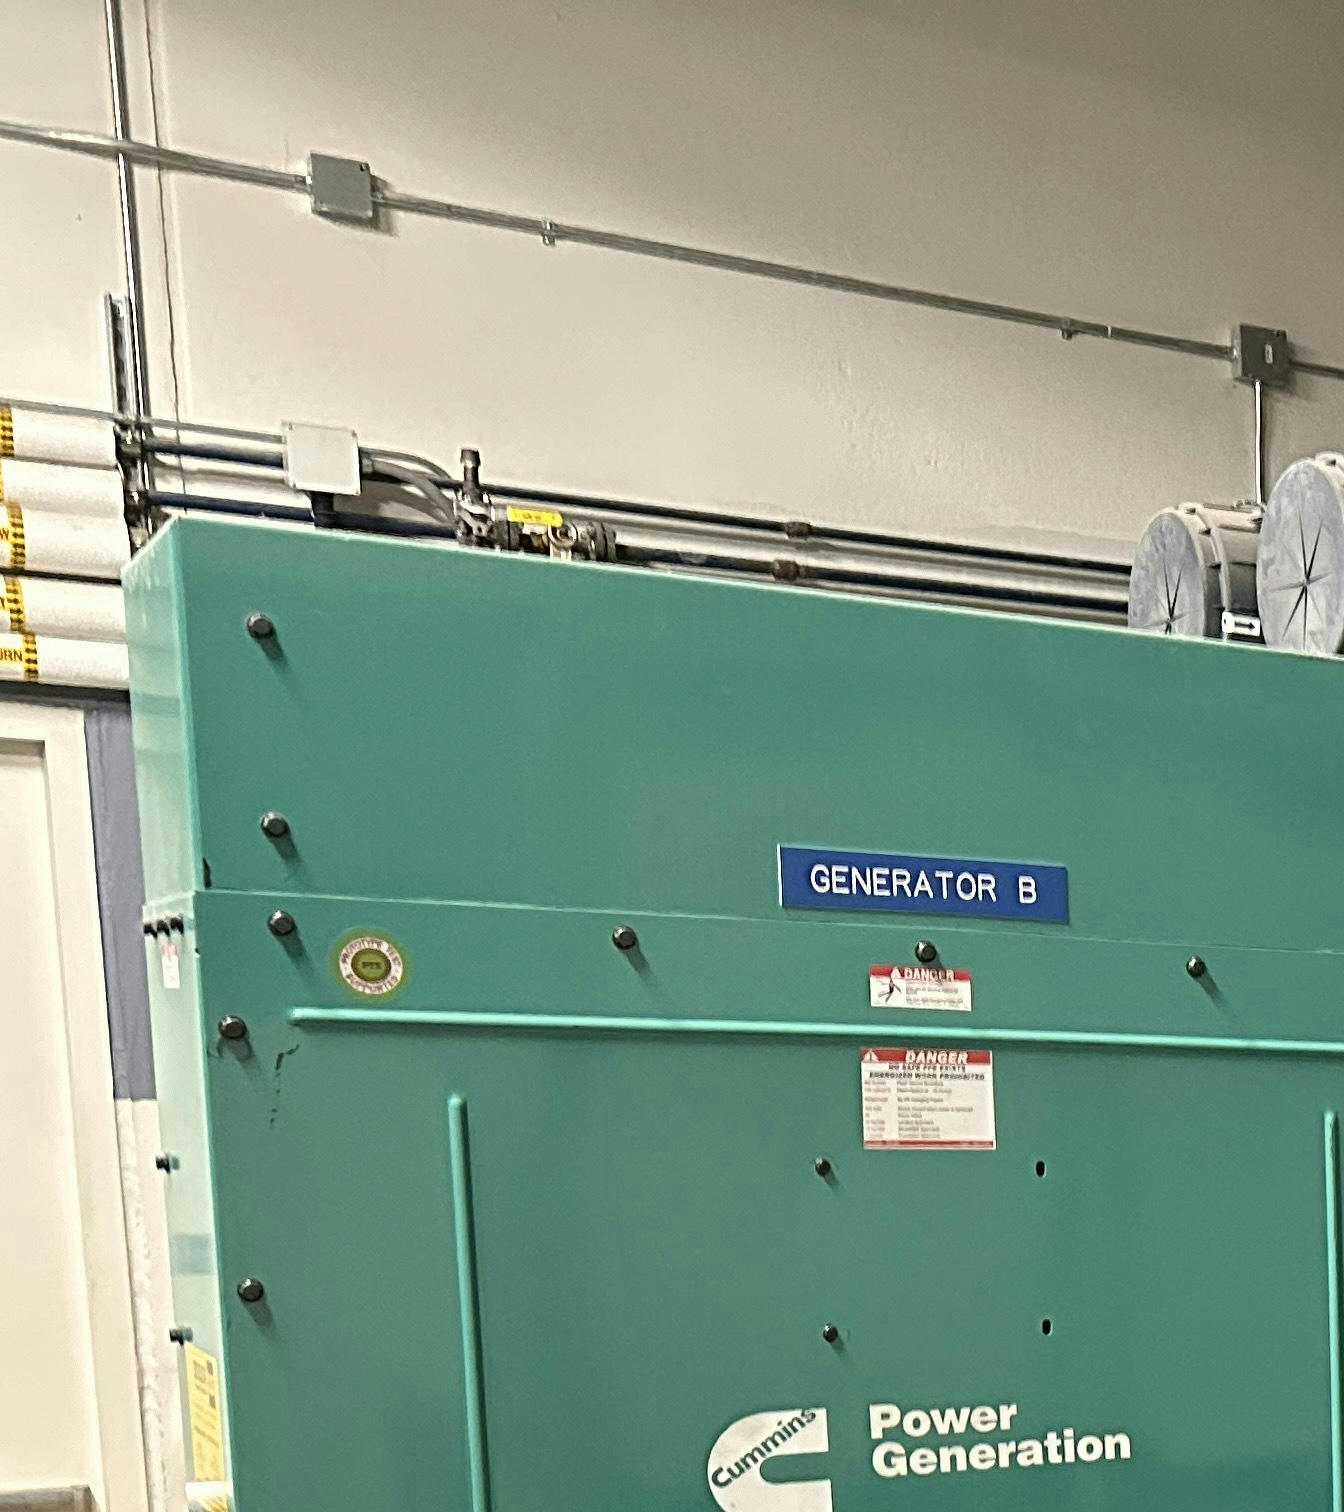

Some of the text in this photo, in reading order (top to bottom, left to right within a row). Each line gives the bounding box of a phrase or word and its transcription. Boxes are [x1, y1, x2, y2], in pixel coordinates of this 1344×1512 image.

[810, 863, 1038, 904] GENERATOR B
[904, 967, 955, 982] DANGER
[905, 1050, 969, 1065] DANGER
[869, 1403, 1018, 1440] Power
[711, 1407, 817, 1490] Cummins
[871, 1427, 1132, 1479] Generation
